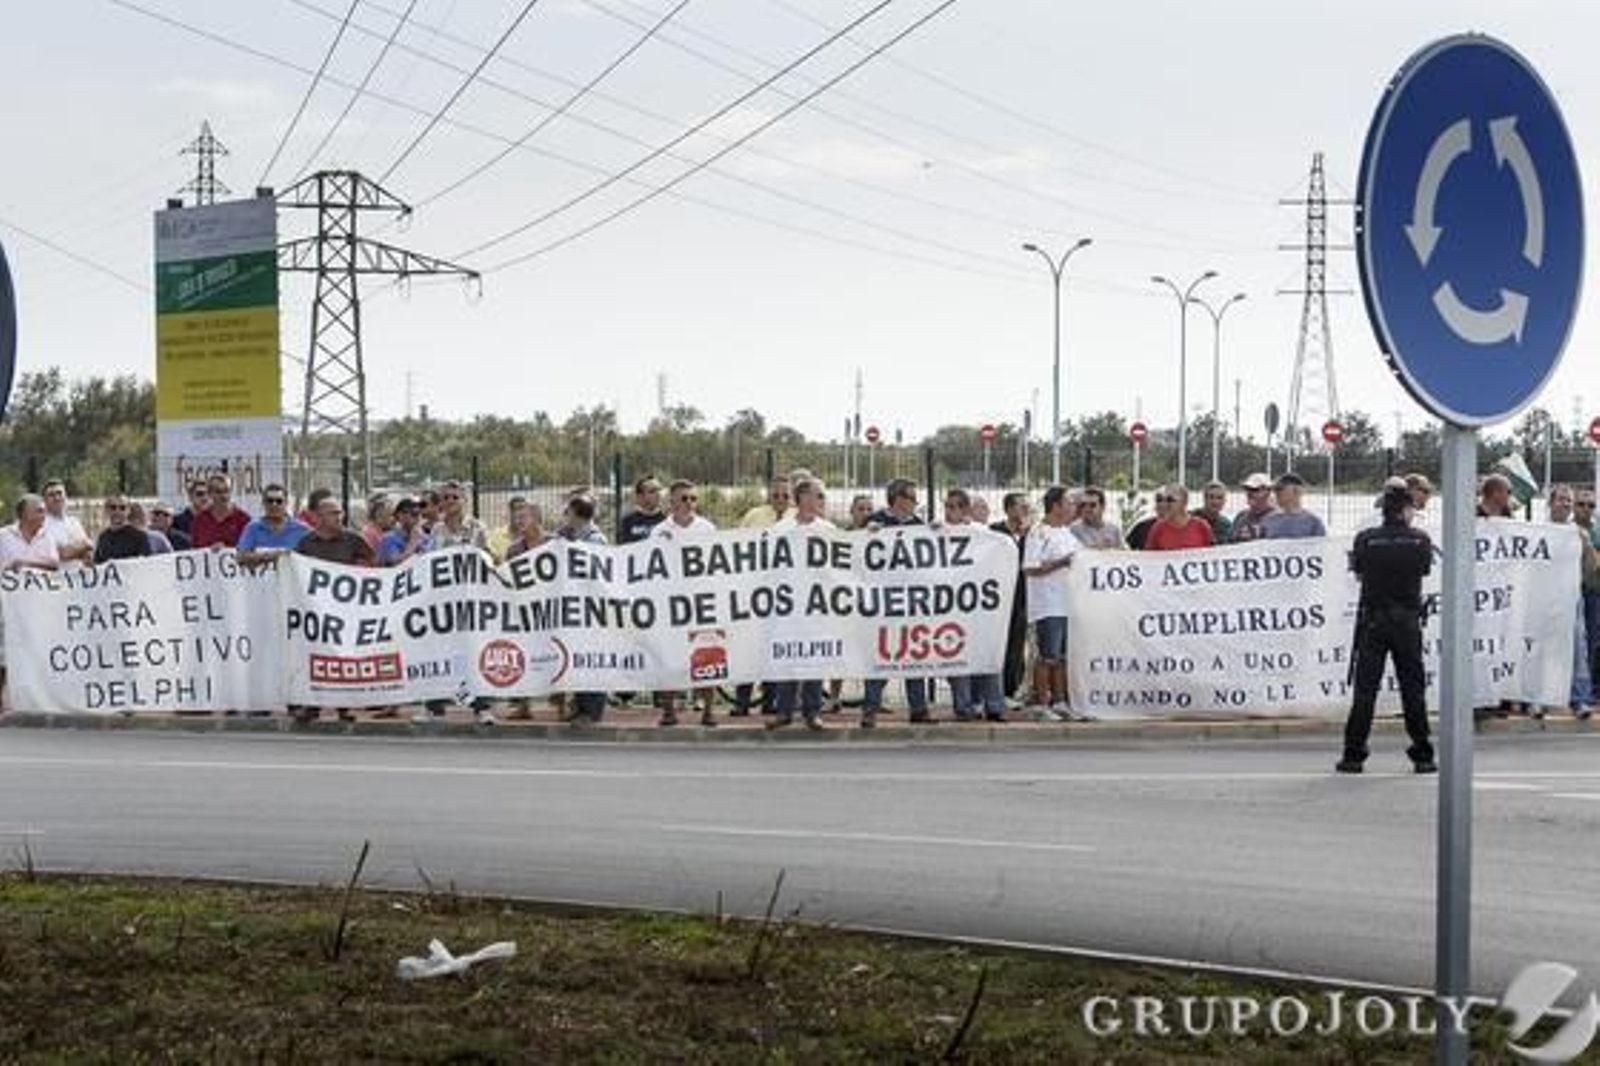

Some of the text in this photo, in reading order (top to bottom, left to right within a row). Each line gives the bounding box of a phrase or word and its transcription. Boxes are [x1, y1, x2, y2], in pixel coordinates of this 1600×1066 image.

[308, 531, 973, 605] POR EL EMEO EN LA BAHÍA DE CÁDIZ
[1091, 535, 1550, 591] LOS ACUERDOS PARA
[67, 595, 223, 630] PARA EL
[287, 580, 1000, 646] POR EL CUMPLIMIENTO DE LOS ACUERDOS
[1138, 605, 1326, 637] CUMPLIRLOS
[50, 636, 252, 671] COLECTIVO
[772, 638, 843, 659] DELPHI
[878, 622, 966, 661] USO
[1090, 654, 1194, 675] CUANDO
[1212, 655, 1224, 670] A
[1244, 651, 1294, 671] UNO
[85, 677, 212, 708] DELPHI
[1090, 690, 1192, 708] CUANDO
[1214, 689, 1246, 706] NO
[1267, 684, 1295, 700] LE
